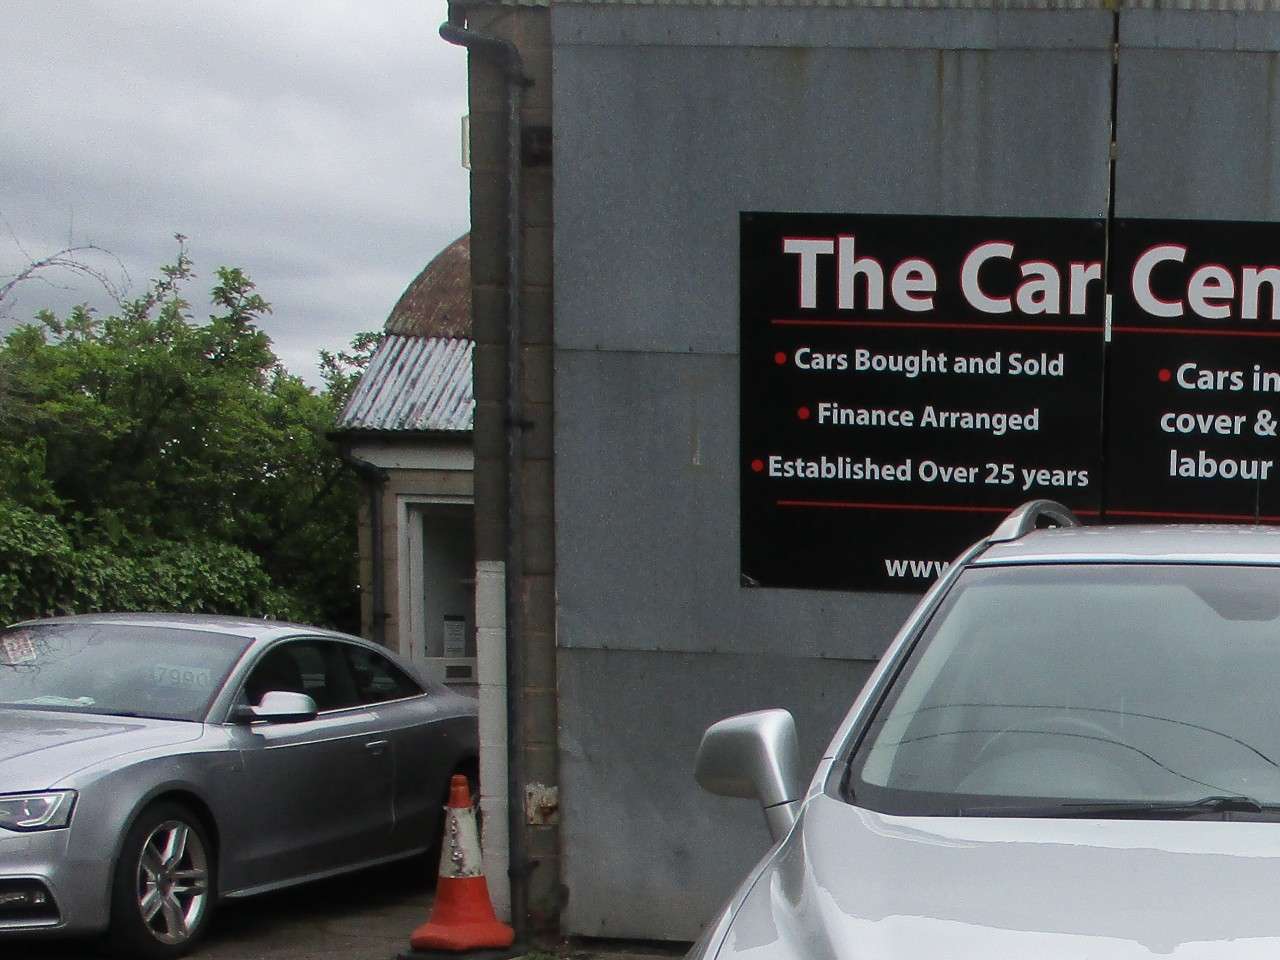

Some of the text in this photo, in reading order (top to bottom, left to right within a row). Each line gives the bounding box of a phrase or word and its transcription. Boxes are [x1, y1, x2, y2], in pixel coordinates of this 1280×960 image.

[784, 237, 936, 311] The
[962, 243, 1101, 314] Car
[795, 348, 1063, 377] Cars Bought and Sold
[1177, 363, 1243, 390] Cars
[819, 403, 1038, 435] Finance Arranged
[1161, 413, 1246, 434] cover
[1254, 410, 1277, 436] &
[769, 456, 1088, 490] Established Over 25 years
[1170, 450, 1273, 479] labour
